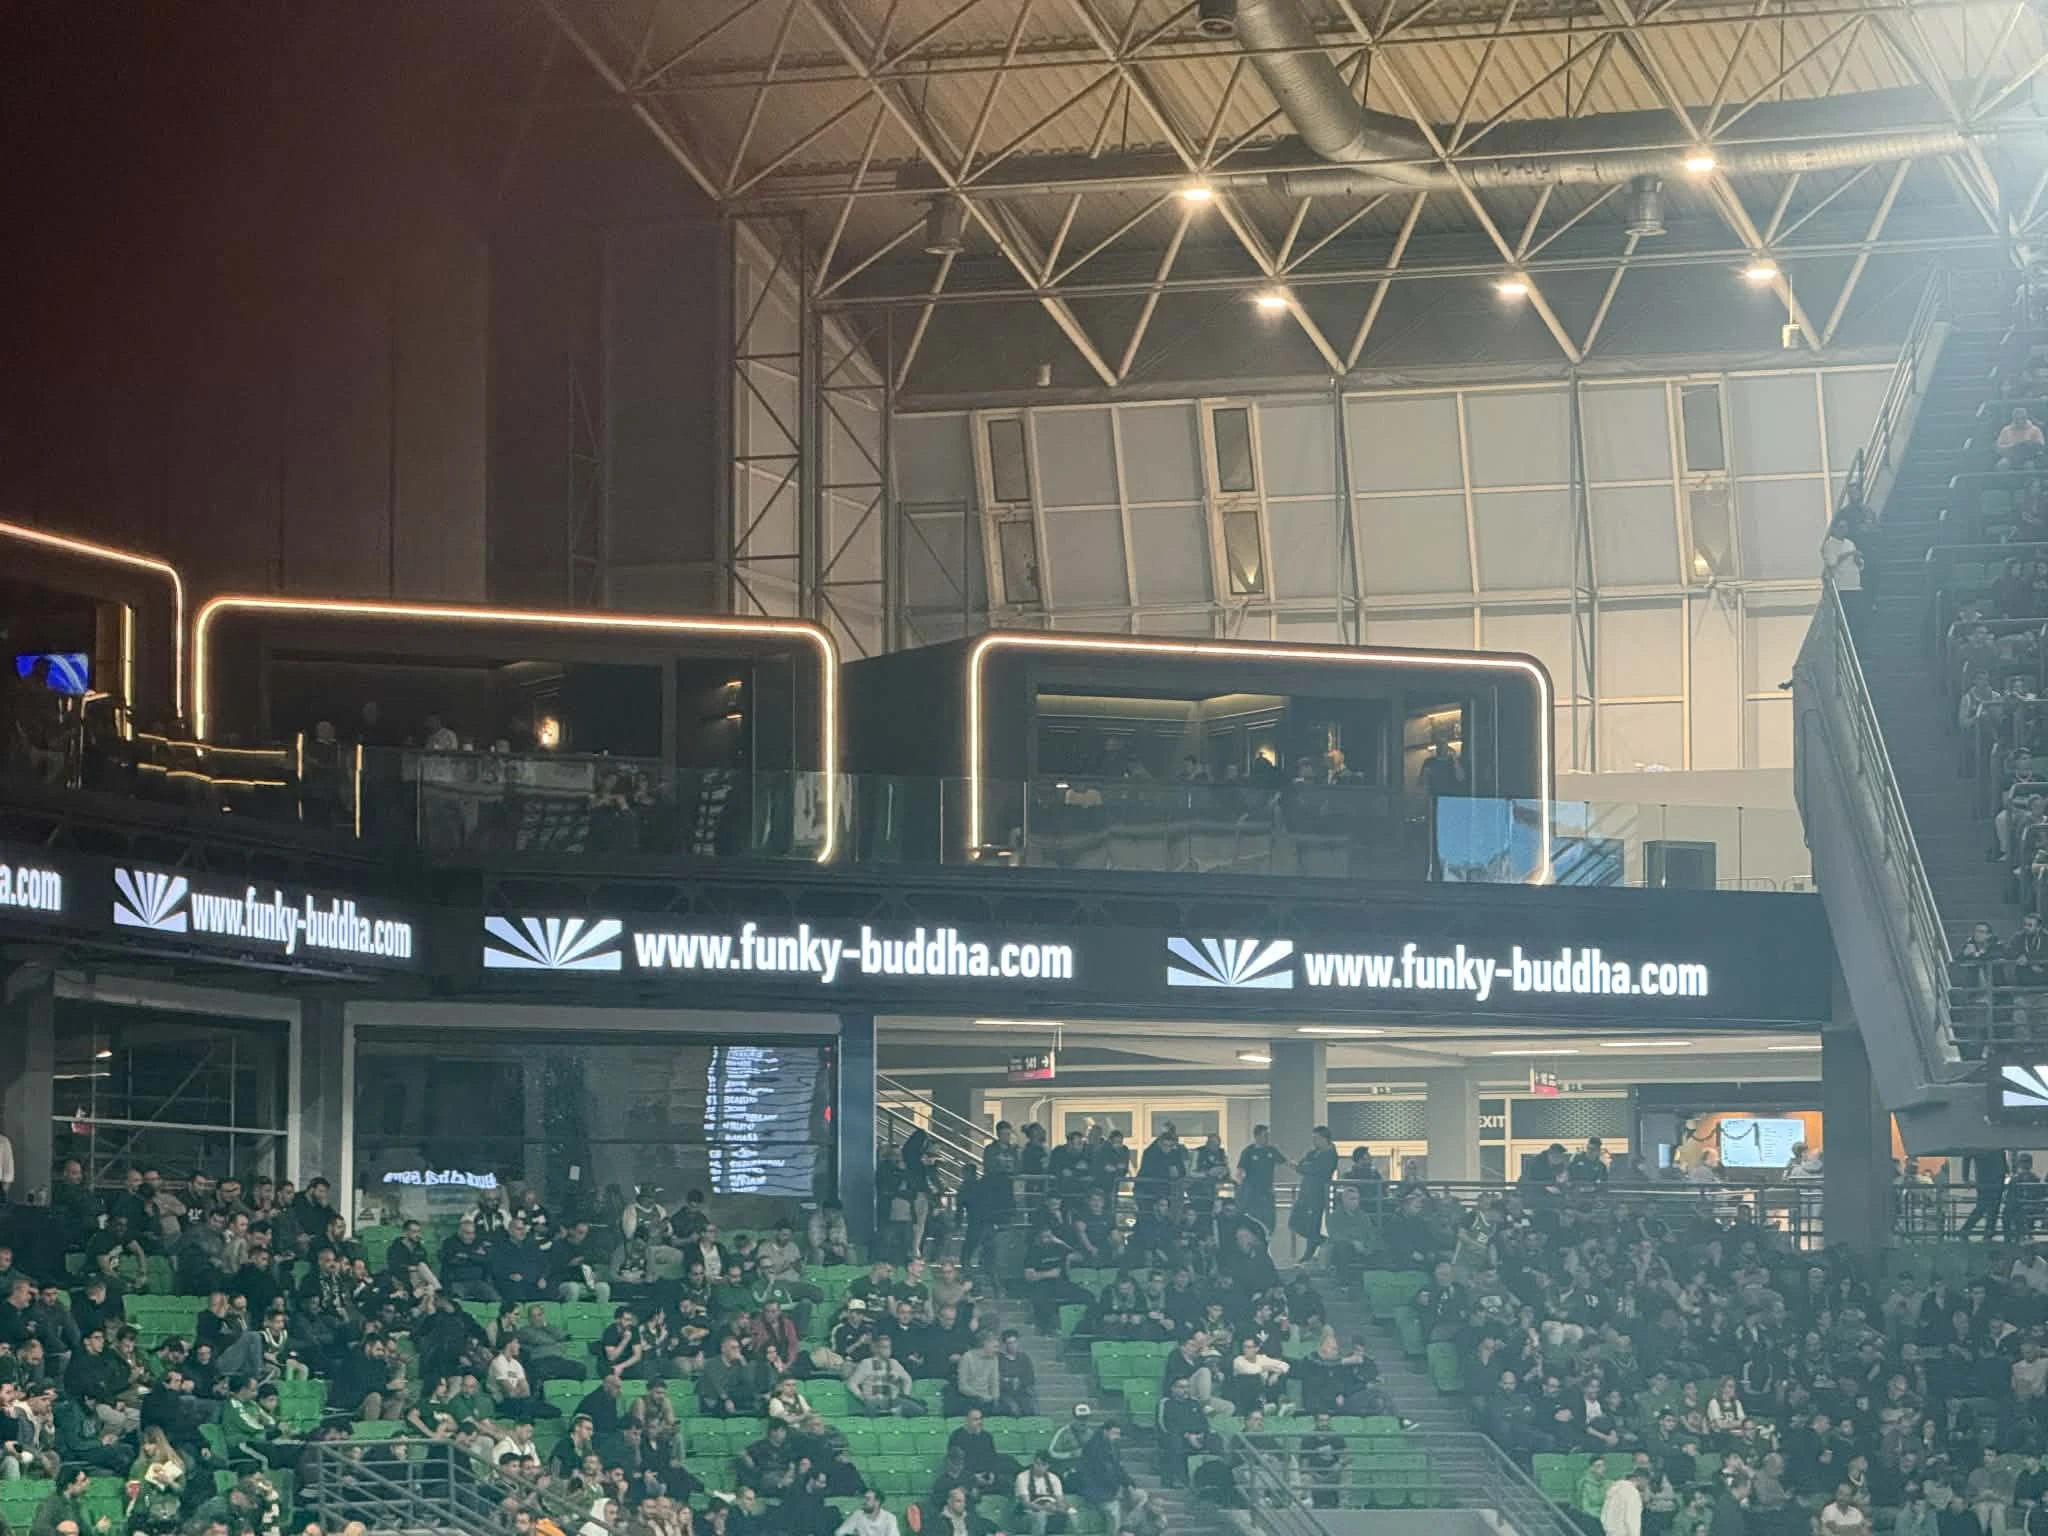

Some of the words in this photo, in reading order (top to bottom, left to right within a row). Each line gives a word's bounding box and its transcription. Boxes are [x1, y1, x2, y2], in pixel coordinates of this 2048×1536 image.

[191, 886, 411, 958] www.funky-buddha.com
[634, 922, 1073, 984] www.funky-buddha.com
[1303, 942, 1709, 1002] www.funky-buddha.com
